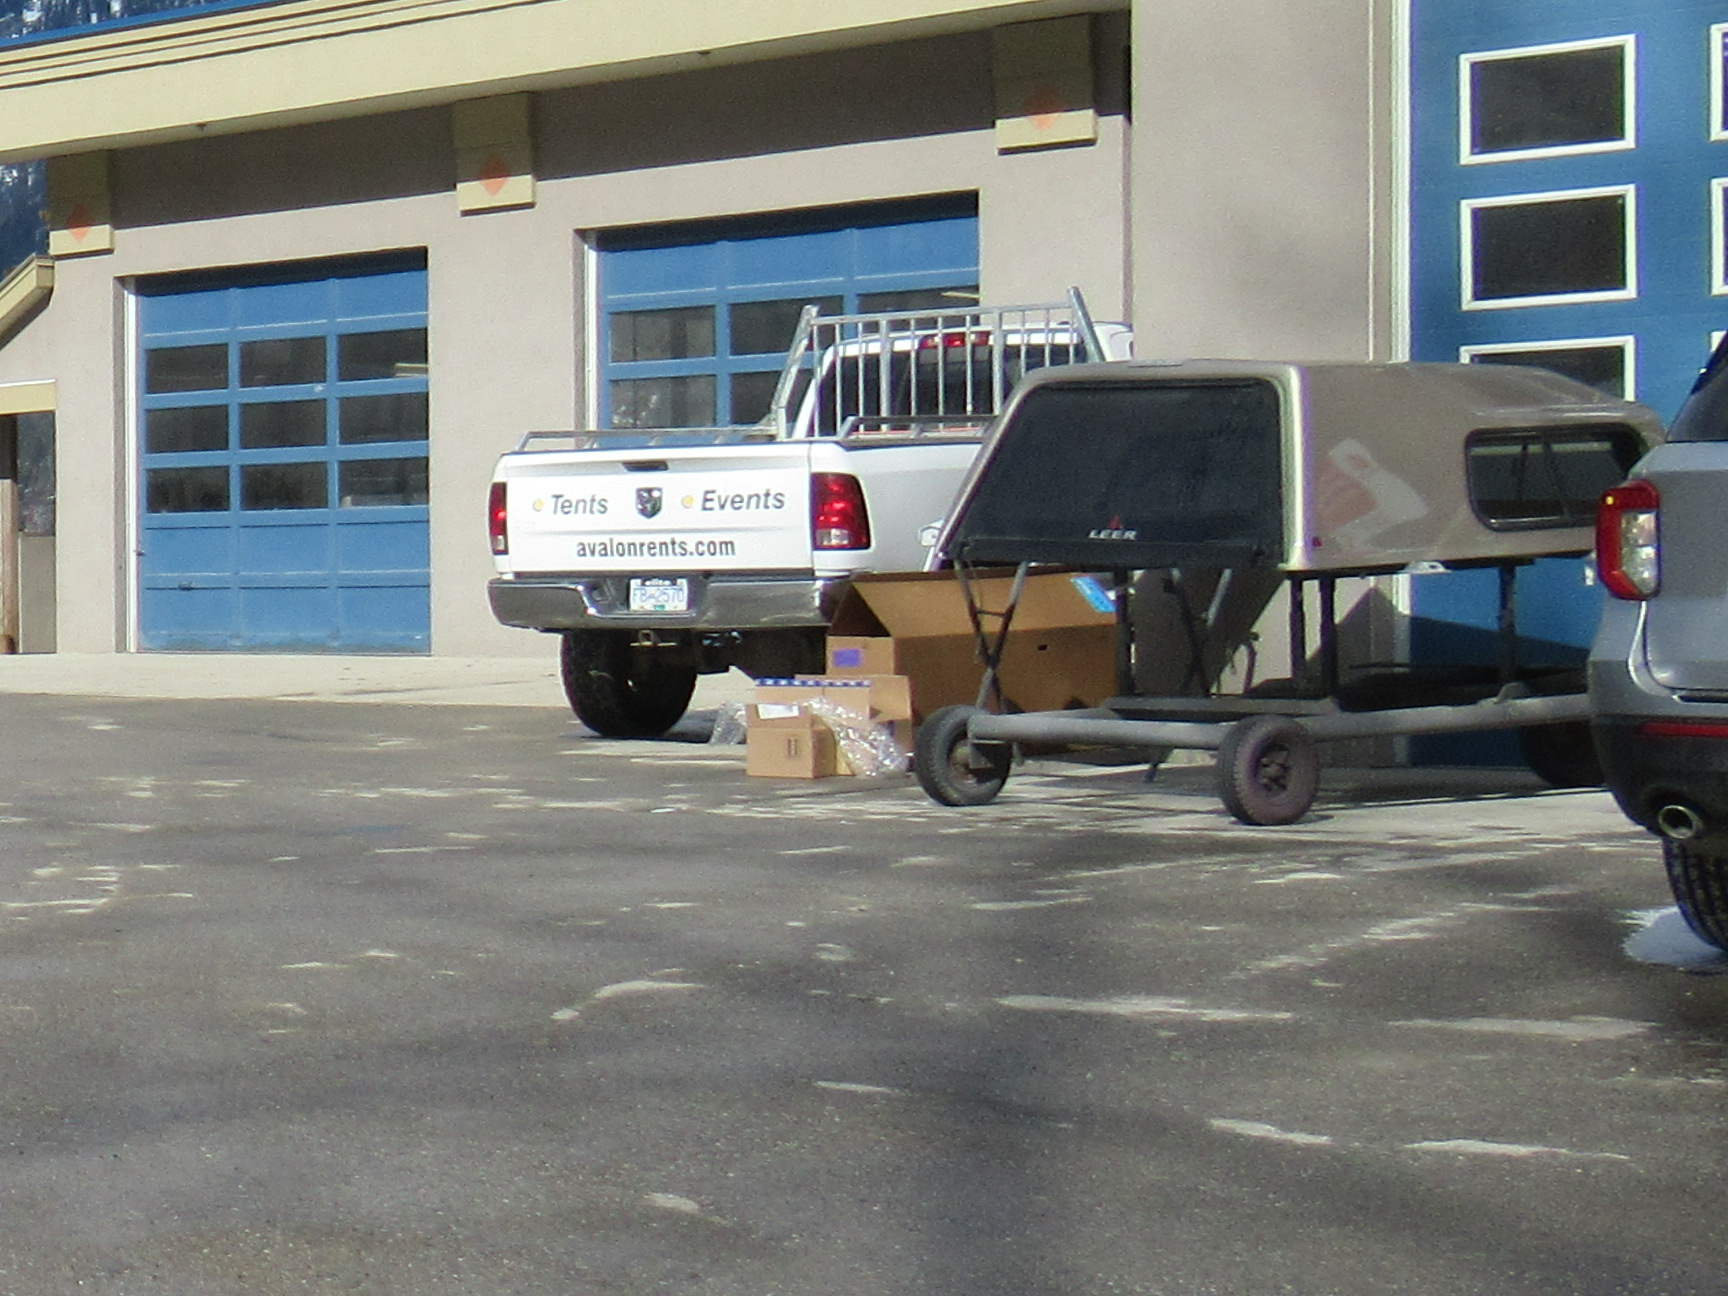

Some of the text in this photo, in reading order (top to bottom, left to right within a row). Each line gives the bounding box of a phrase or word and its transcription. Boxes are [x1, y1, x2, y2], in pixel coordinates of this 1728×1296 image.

[550, 488, 786, 515] Tents Events
[1088, 528, 1137, 541] LEER
[576, 537, 736, 557] avalonrents.com
